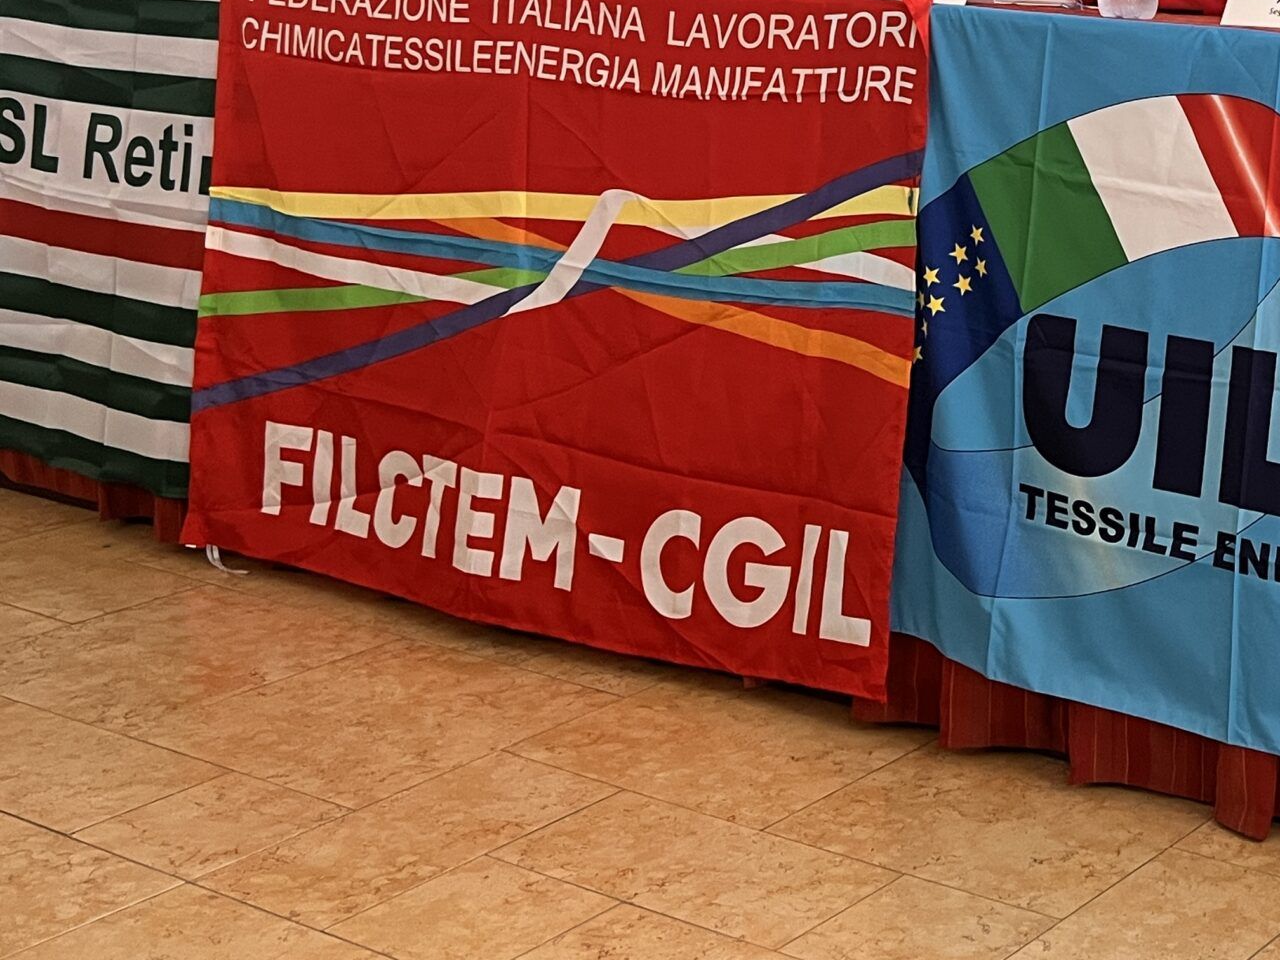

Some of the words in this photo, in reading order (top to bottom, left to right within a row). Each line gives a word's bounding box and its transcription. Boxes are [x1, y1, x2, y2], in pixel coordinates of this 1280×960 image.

[241, 17, 641, 93] CHIMICATESSILEENERGIA
[651, 60, 917, 104] MANIFATTURE
[667, 9, 918, 50] LAVORATORI
[1019, 482, 1199, 562] TESSILE
